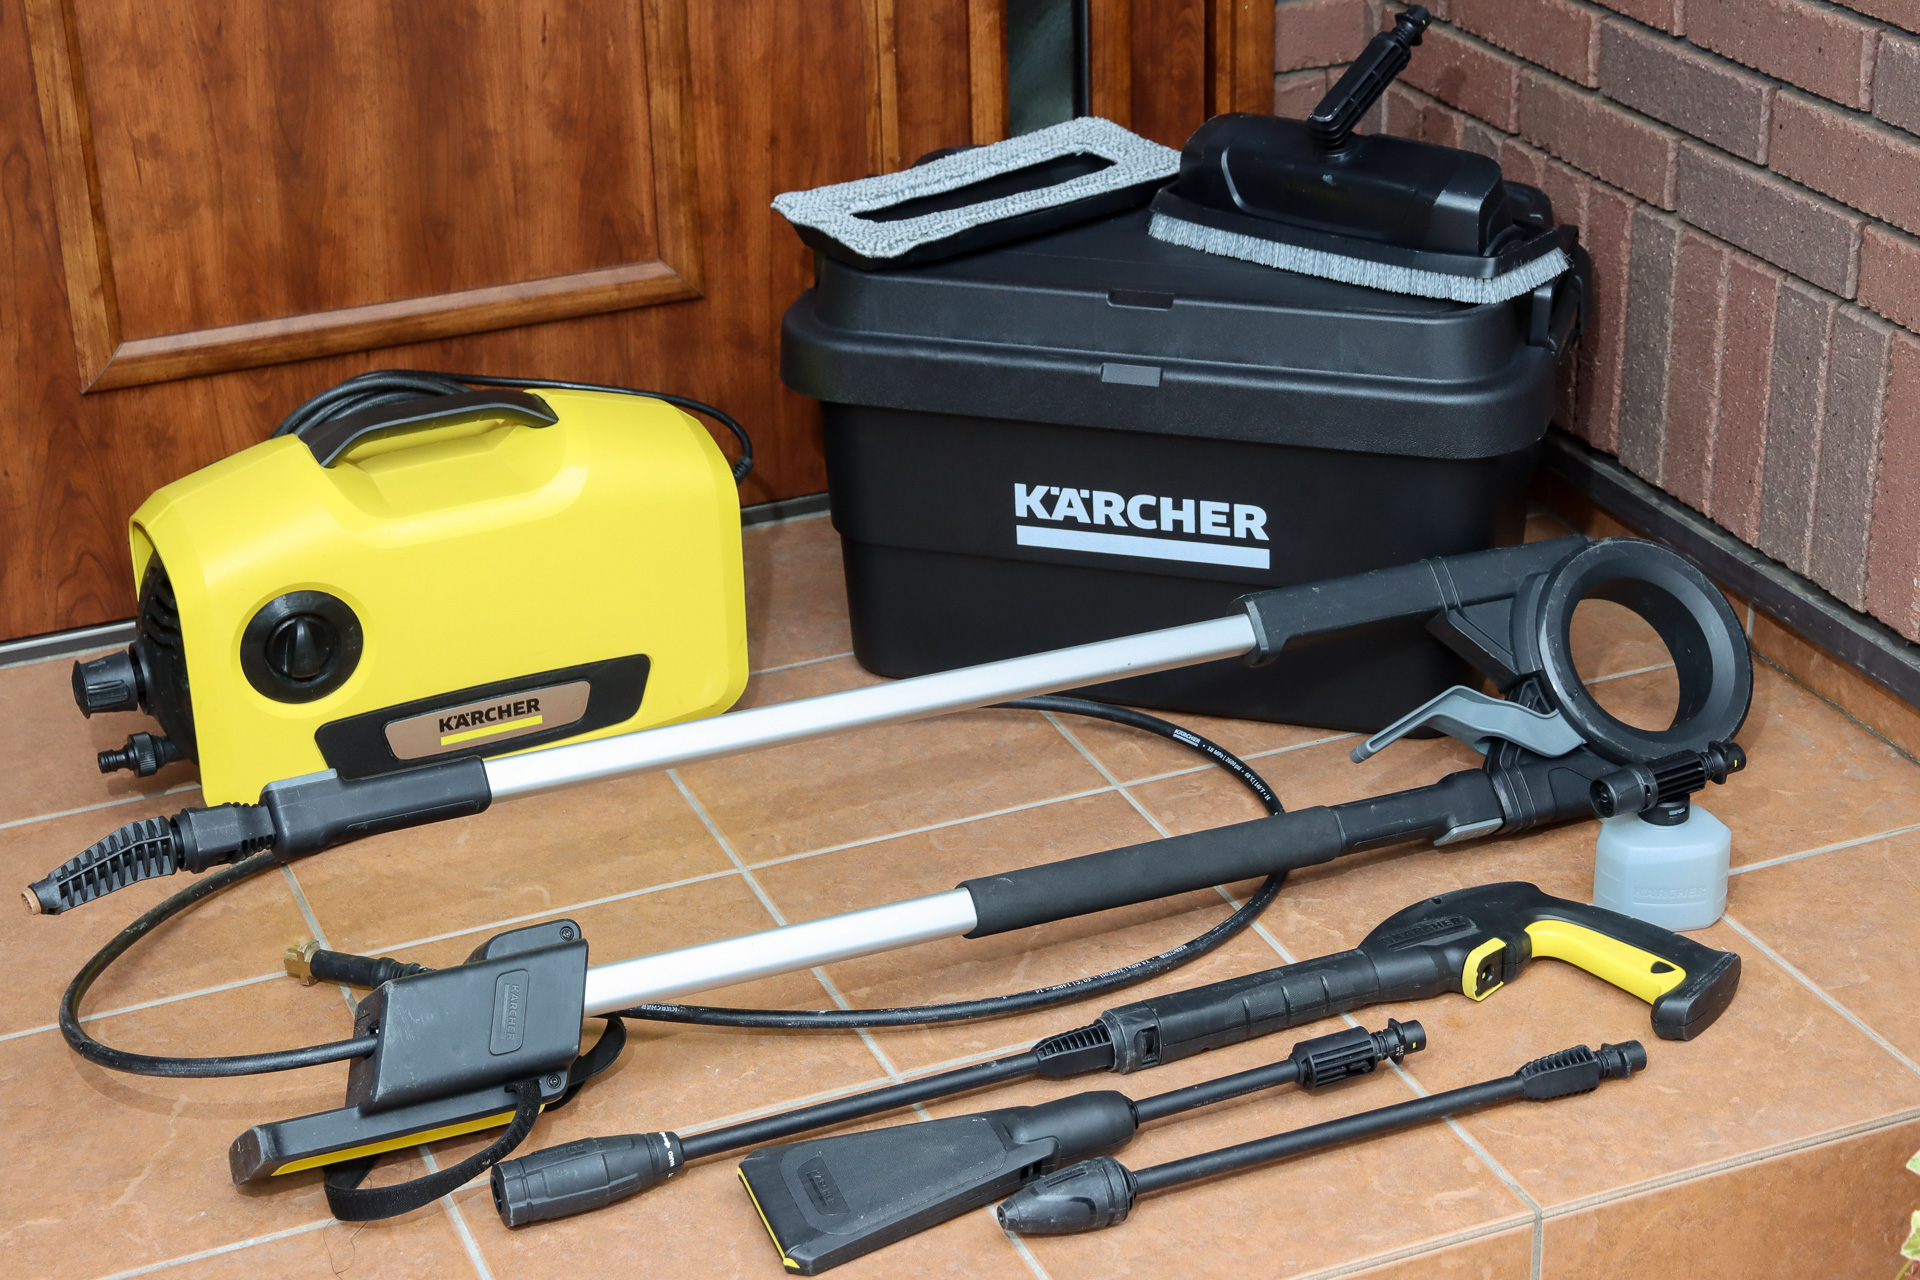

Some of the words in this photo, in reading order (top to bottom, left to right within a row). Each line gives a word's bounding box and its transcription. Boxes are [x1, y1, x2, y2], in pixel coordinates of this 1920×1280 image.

[1014, 483, 1270, 541] KÄRCHER
[438, 698, 541, 733] KÄRCHER
[506, 984, 520, 1041] KÄRCHER
